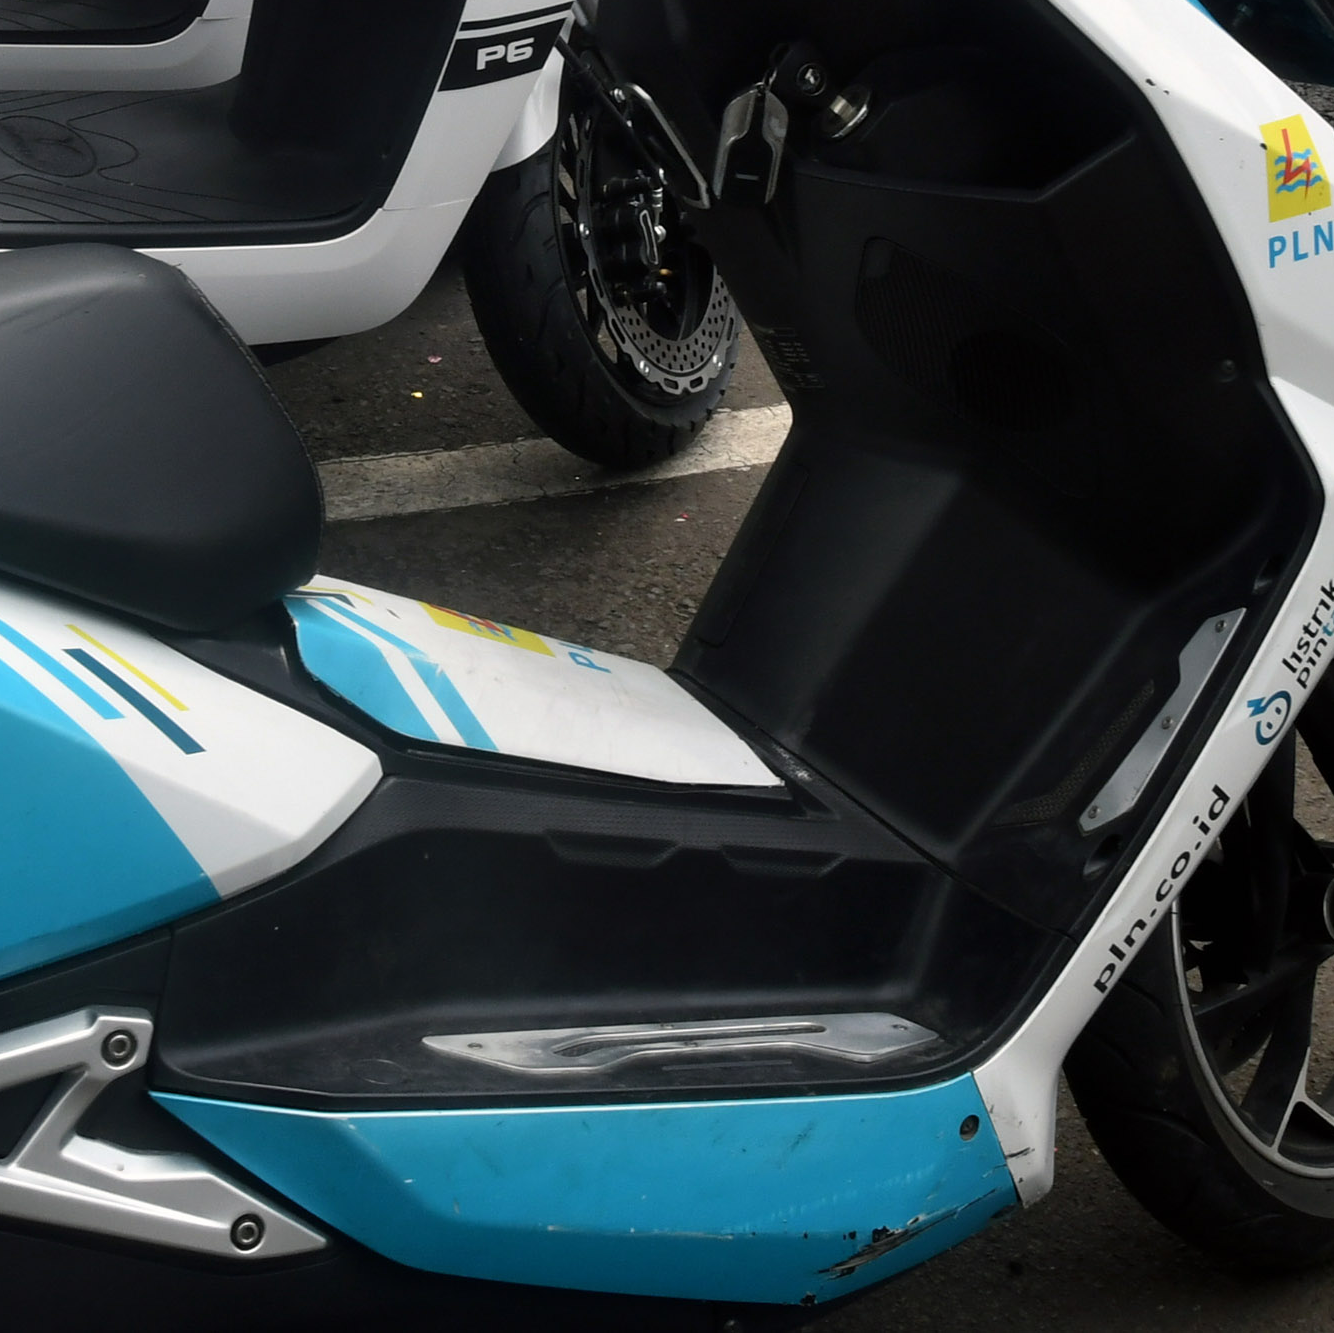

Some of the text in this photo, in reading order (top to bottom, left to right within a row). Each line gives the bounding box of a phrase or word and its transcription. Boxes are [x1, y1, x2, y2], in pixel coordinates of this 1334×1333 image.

[476, 37, 535, 71] P6
[1268, 220, 1334, 269] PLN
[1094, 784, 1231, 996] pln.co.id
